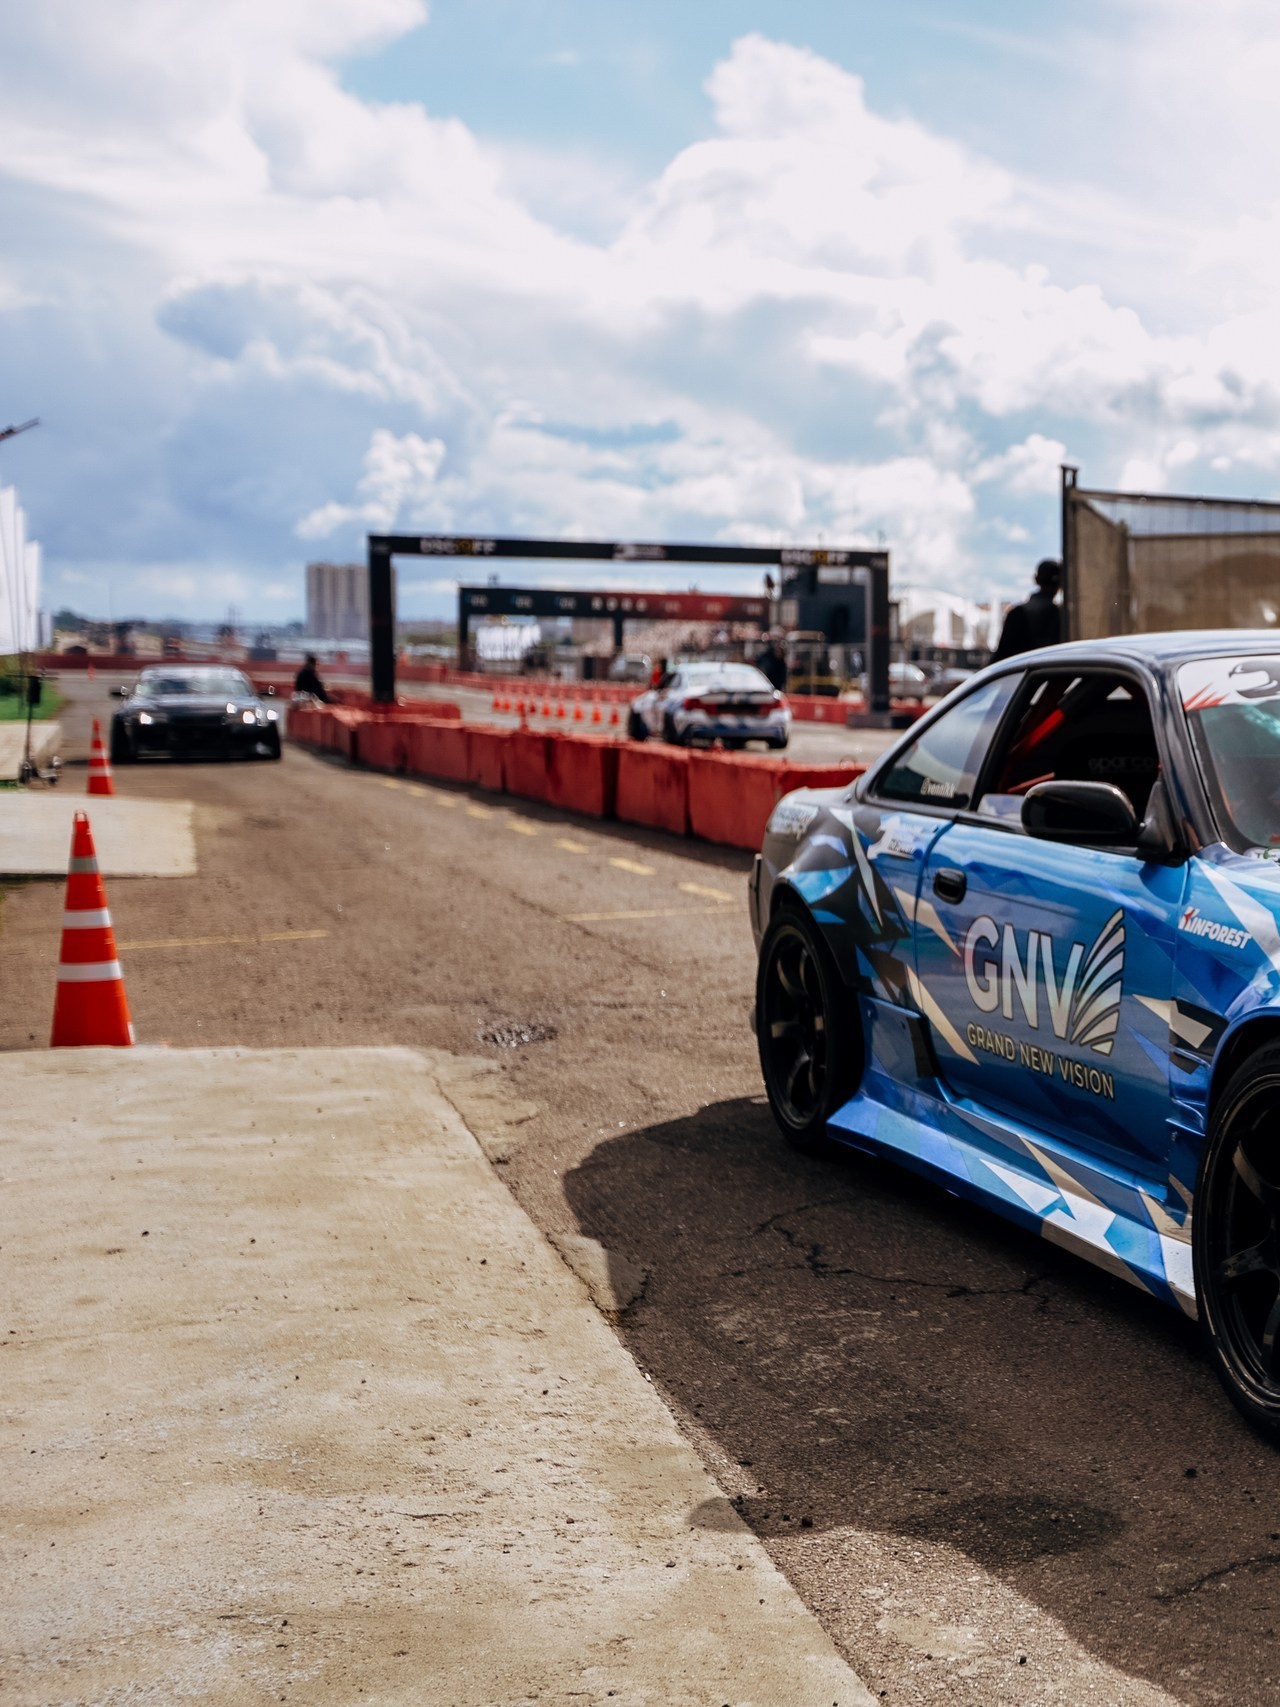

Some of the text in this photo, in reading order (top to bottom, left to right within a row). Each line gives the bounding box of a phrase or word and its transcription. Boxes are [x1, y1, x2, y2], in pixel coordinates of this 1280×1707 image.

[1178, 906, 1252, 949] KINFOREST
[964, 915, 1085, 1040] GNV
[966, 1020, 1115, 1101] GRAND NEW VISION
